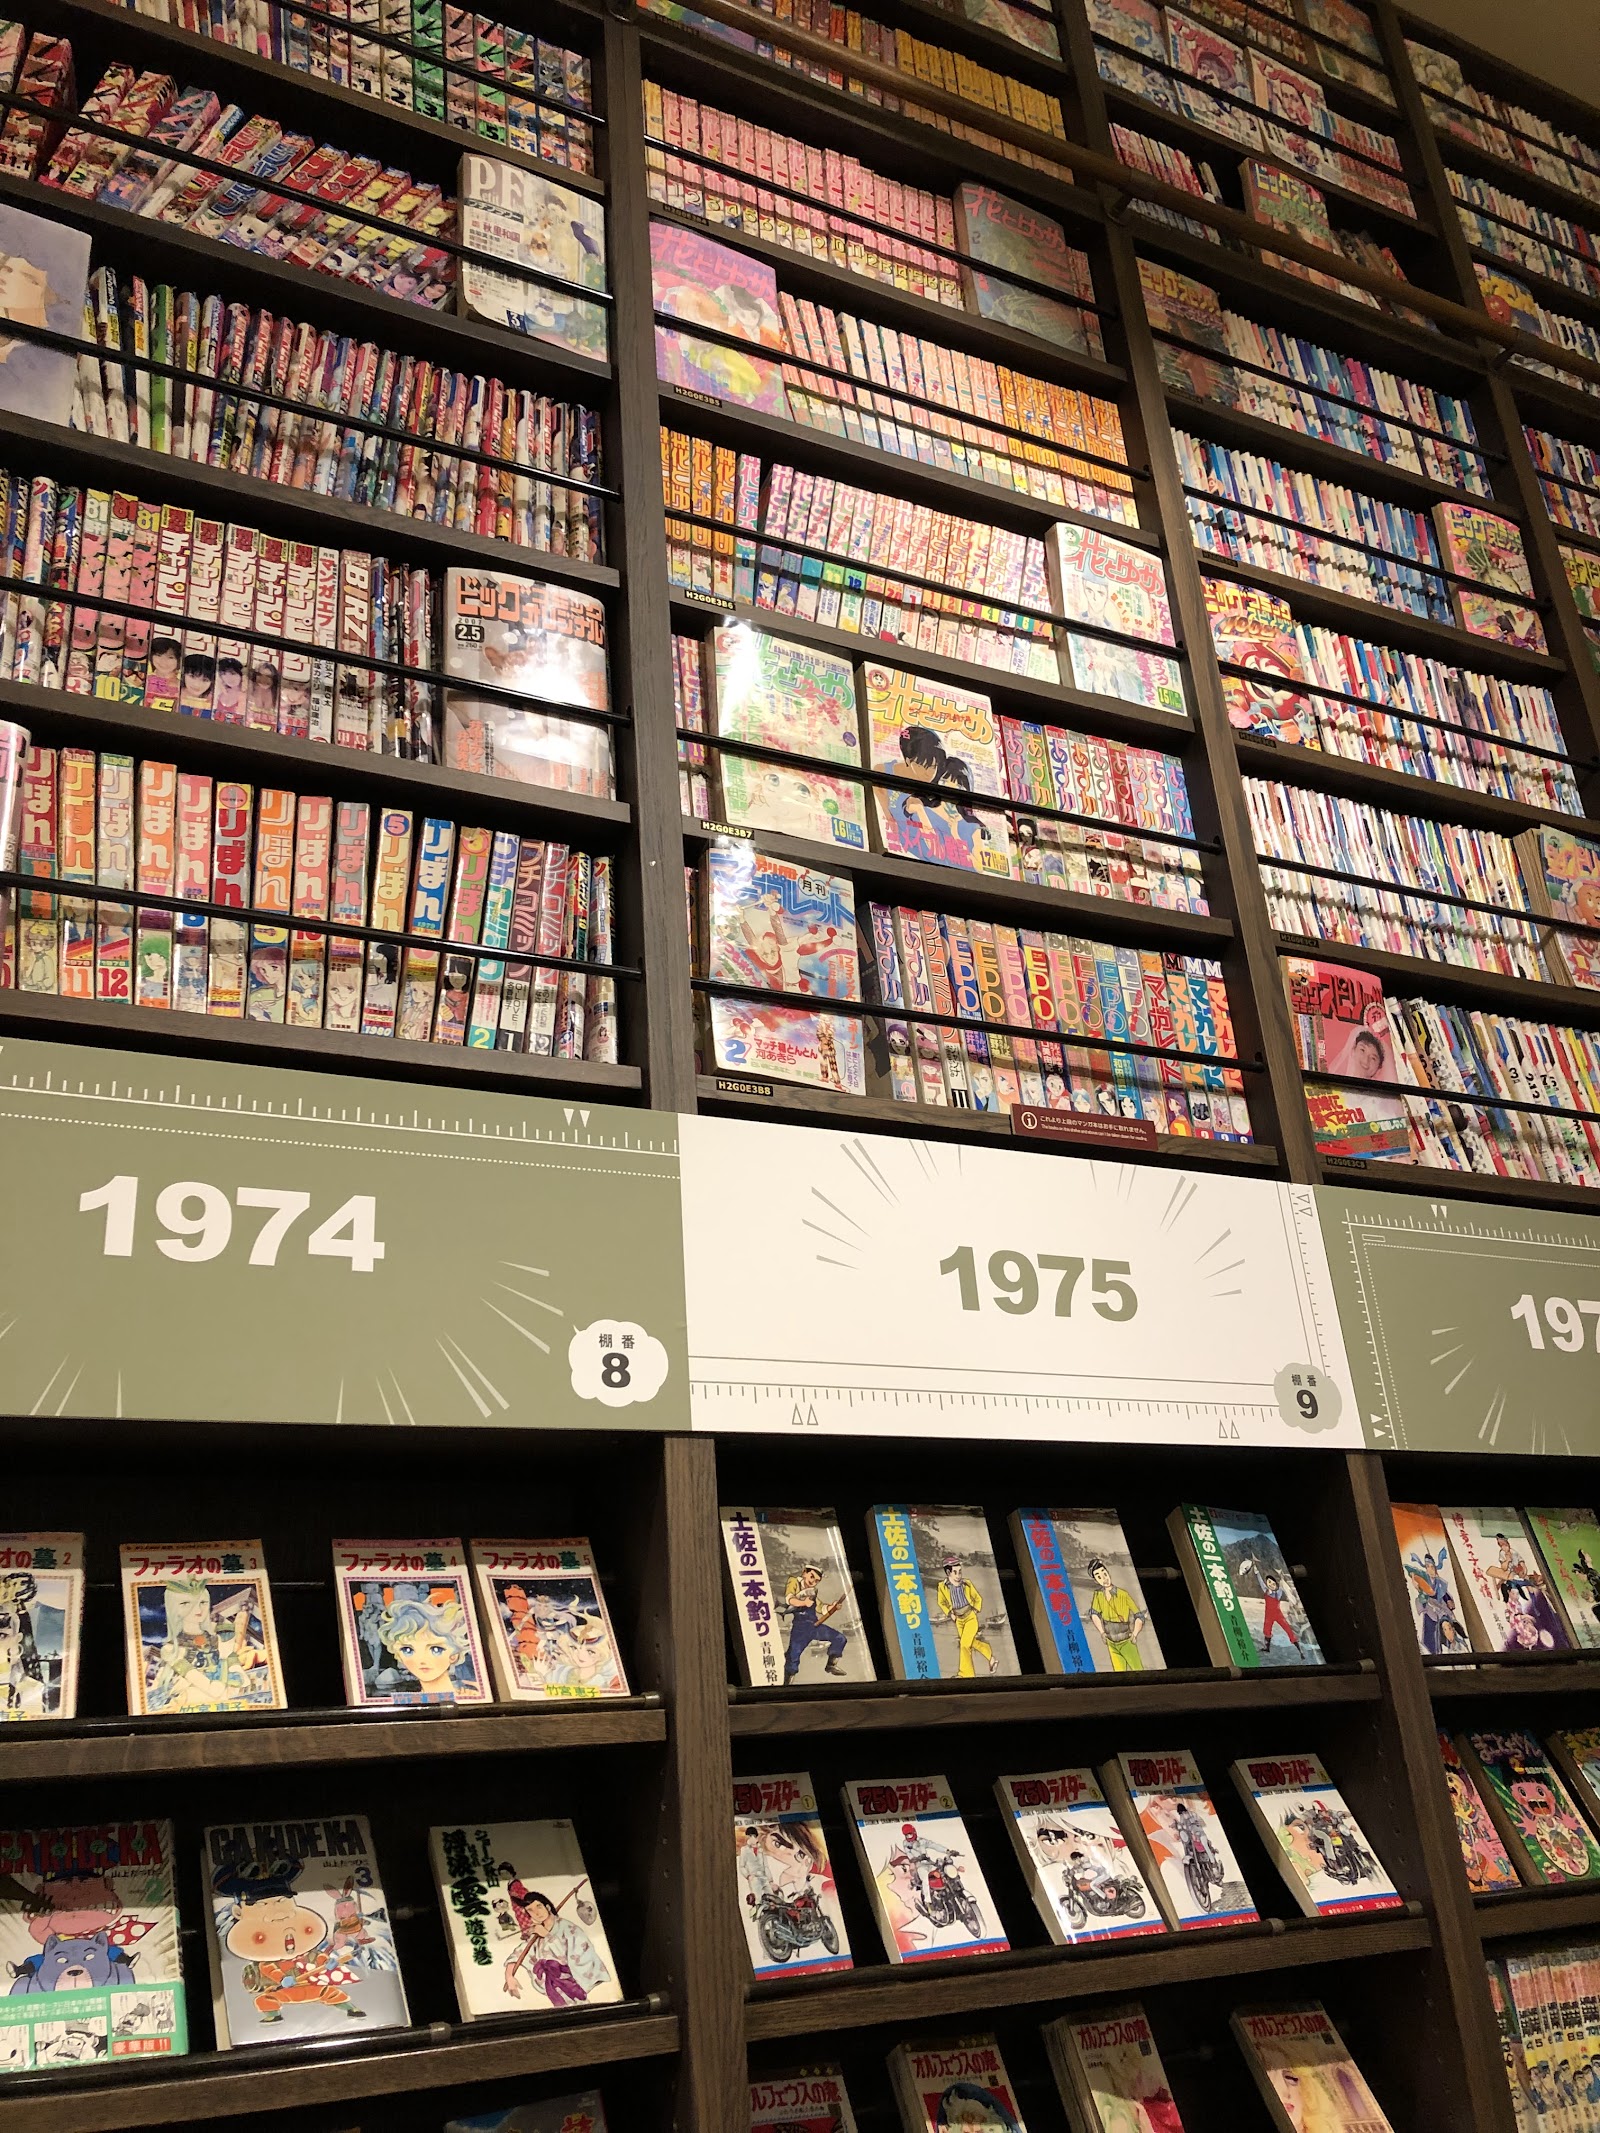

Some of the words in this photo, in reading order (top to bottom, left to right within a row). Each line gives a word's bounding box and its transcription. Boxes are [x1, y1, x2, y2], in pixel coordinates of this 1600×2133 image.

[675, 386, 721, 407] H2G0E3B5
[1063, 528, 1167, 598] 花とゆめ
[343, 563, 370, 642] BIRZ
[456, 574, 521, 623] ビッグ
[686, 590, 735, 610] H2G0E3B6
[457, 626, 482, 640] 2.5
[867, 669, 995, 745] 花とゆめ
[23, 747, 56, 847] りぼん
[62, 763, 96, 870] りぼん
[141, 766, 173, 870] りぼん
[100, 769, 131, 872] りぼん
[177, 783, 210, 886] りぼん
[386, 815, 404, 836] 5
[702, 822, 753, 838] H2G0E3B7
[213, 808, 247, 909] りぼん
[259, 792, 296, 906] りぼん
[297, 803, 329, 901] りぼん
[333, 808, 365, 907] りぼん
[375, 836, 405, 934] りぼん
[410, 825, 450, 923] りぼん
[802, 879, 827, 897] 月刊
[63, 966, 94, 999] 11
[98, 966, 128, 998] 12
[948, 935, 980, 1012] EPO
[973, 940, 1006, 1018] EPO
[998, 943, 1031, 1021] EPO
[1023, 945, 1055, 1021] EPO
[1165, 954, 1183, 971] M
[1184, 956, 1203, 975] M
[1203, 959, 1224, 978] M
[1050, 950, 1081, 1025] EPO
[1071, 955, 1104, 1029] EPO
[1095, 960, 1127, 1035] EPO
[1117, 964, 1149, 1038] EPO
[472, 1027, 490, 1050] 2
[503, 1030, 514, 1051] 1
[724, 1039, 748, 1064] 2
[718, 1081, 772, 1096] H2G0E3B8
[79, 1175, 385, 1272] 1974
[938, 1245, 1139, 1322] 1975
[598, 1333, 635, 1350] 棚番
[600, 1352, 632, 1389] 8
[1291, 1373, 1317, 1388] 棚番
[1297, 1390, 1319, 1419] 9
[63, 1552, 71, 1565] 2
[129, 1554, 245, 1577] ファラオの墓
[249, 1558, 258, 1569] 3
[341, 1551, 447, 1572] ファラオの墓
[482, 1551, 581, 1571] ファラオの墓
[729, 1511, 771, 1637] 土佐の一本釣り
[881, 1506, 923, 1630] 土佐の一本釣り
[1026, 1510, 1073, 1626] 土佐の一本釣り
[1188, 1505, 1235, 1613] 土佐の一本釣り
[758, 1641, 779, 1686] 青柳裕
[910, 1632, 930, 1680] 青柳裕
[1066, 1628, 1084, 1673] 青柳裕
[1010, 1773, 1087, 1807] 750ライダー
[1128, 1757, 1187, 1786] 750ライダー
[1248, 1759, 1316, 1787] 750ライダー
[732, 1779, 801, 1815] 50ライダー
[857, 1782, 938, 1815] 750ライダー
[209, 1819, 368, 1866] GAKIDEKA
[354, 1866, 374, 1888] 3
[442, 1829, 491, 1918] 浮浪雲
[1247, 2014, 1333, 2039] オルフェウスの窓
[911, 2049, 1000, 2080] オルフェウスの窓
